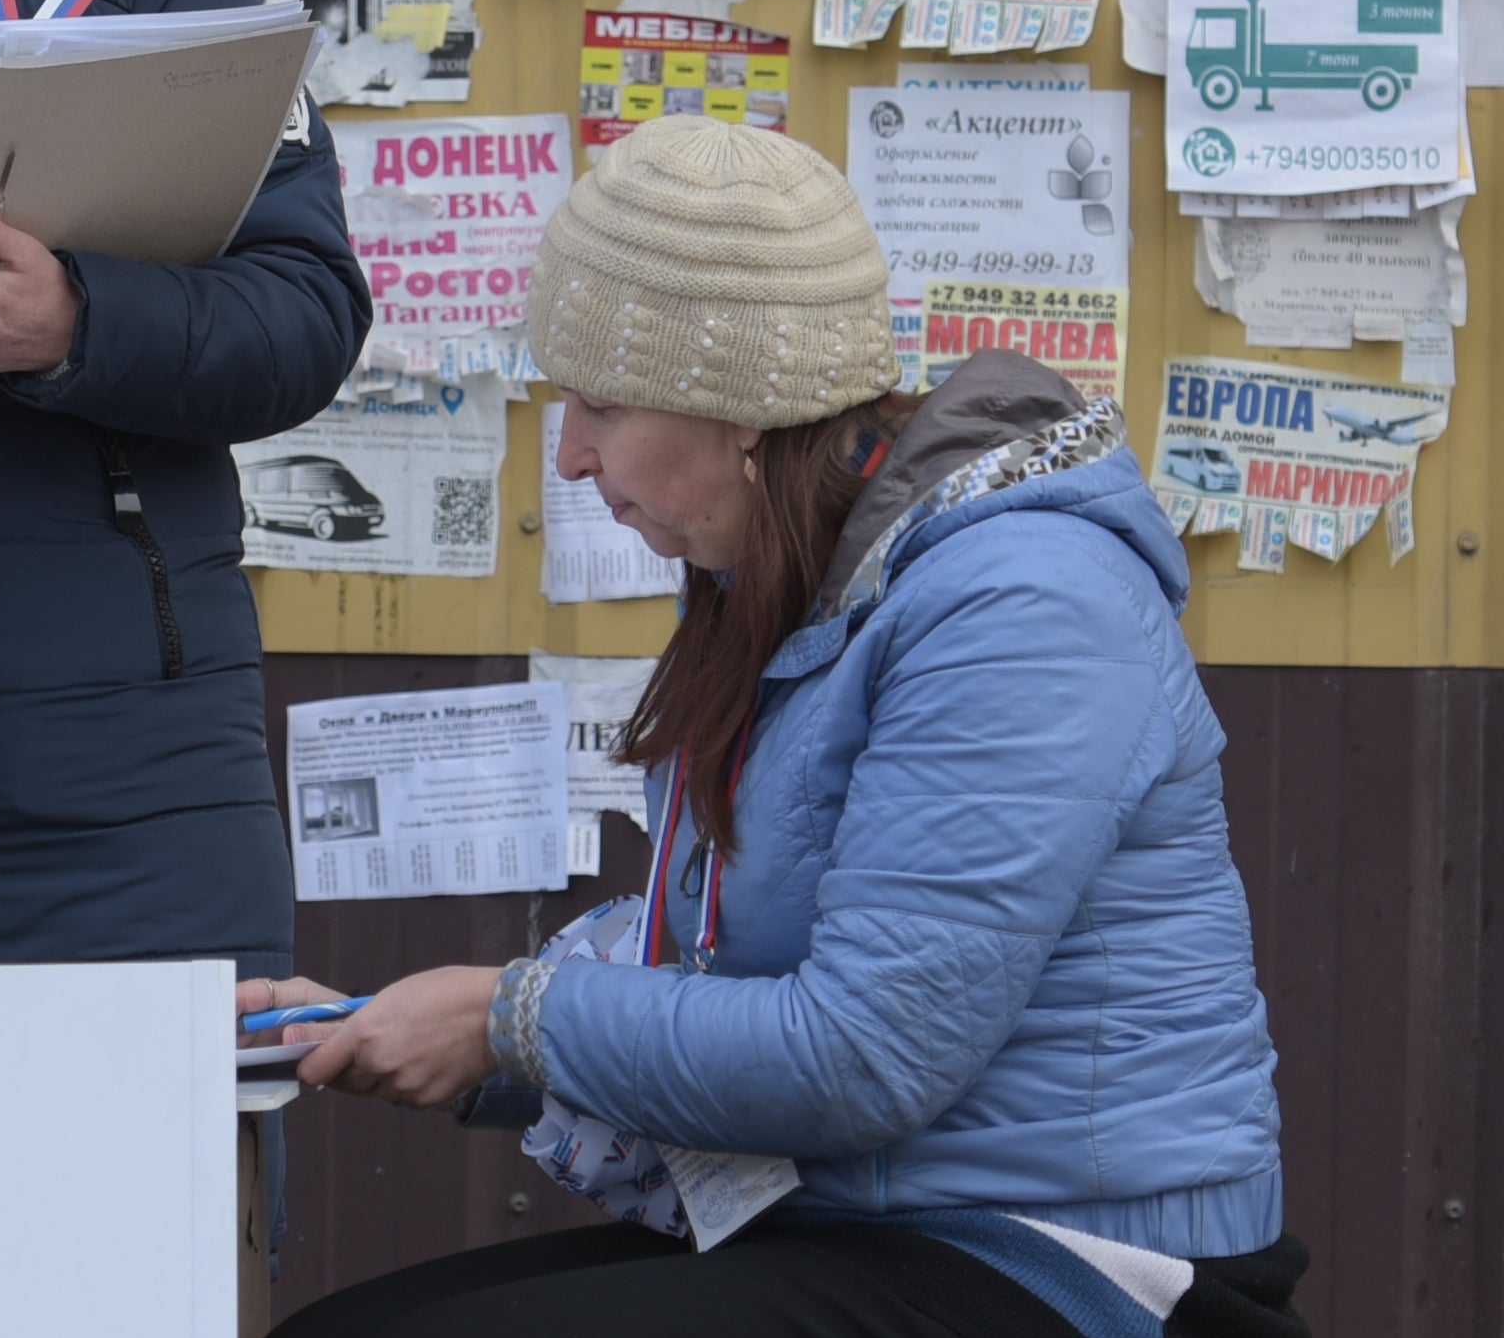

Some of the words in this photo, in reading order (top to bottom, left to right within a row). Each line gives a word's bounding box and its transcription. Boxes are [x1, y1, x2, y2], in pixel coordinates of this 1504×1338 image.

[925, 108, 1083, 136] «Акцент»
[373, 133, 559, 186] ДОНЕЦК
[1244, 145, 1442, 172] +79490035010
[927, 314, 1118, 361] МОСКВА
[1167, 375, 1314, 434] ЕВРОПА
